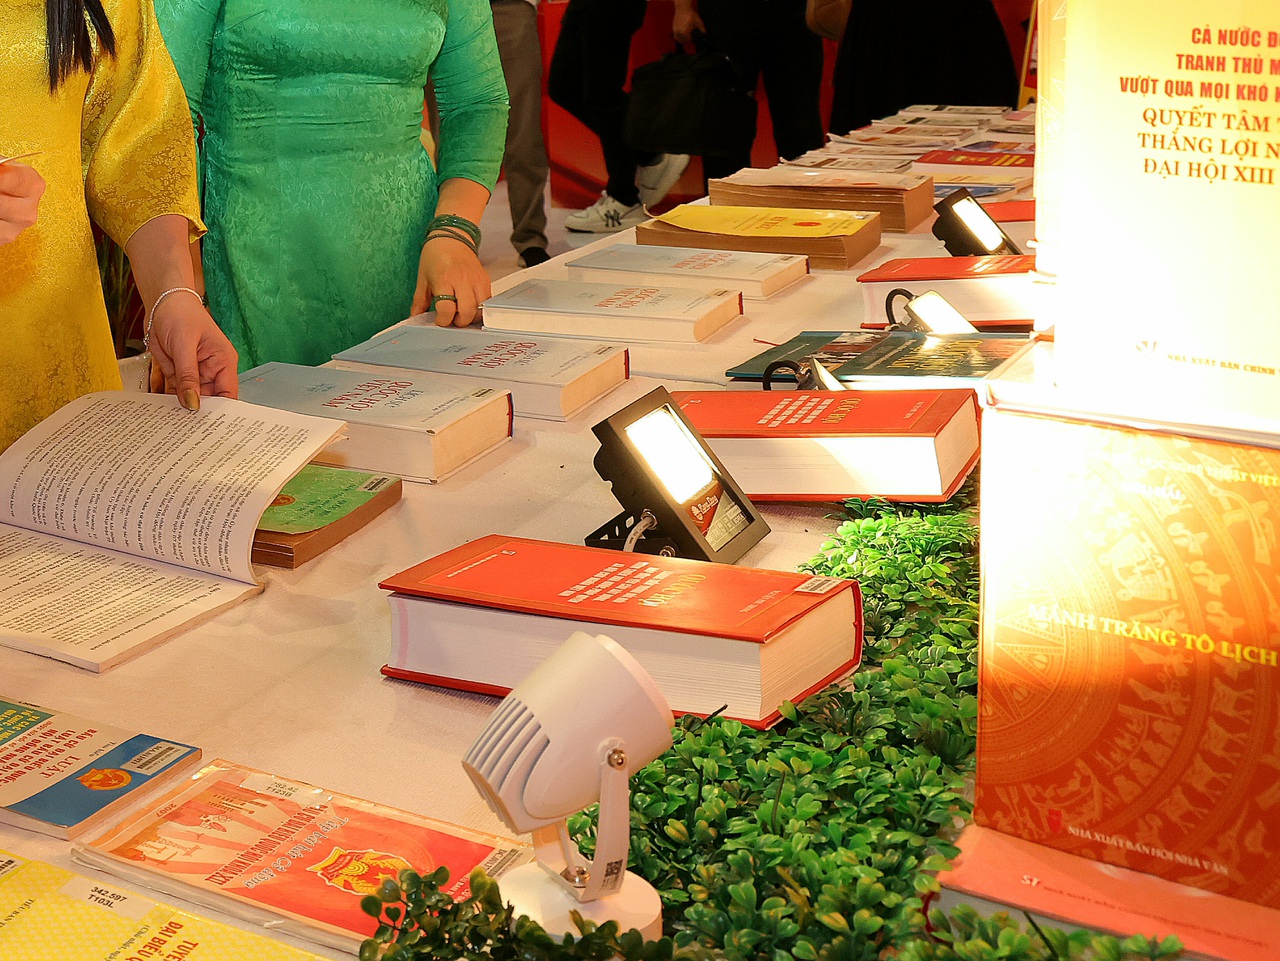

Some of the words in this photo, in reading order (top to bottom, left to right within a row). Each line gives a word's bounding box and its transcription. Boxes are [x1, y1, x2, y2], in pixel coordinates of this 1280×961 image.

[1192, 24, 1212, 45] CẢ
[1218, 24, 1261, 48] NƯỚC
[1176, 53, 1227, 73] TRANH
[1233, 53, 1264, 75] THỦ
[1119, 75, 1159, 98] VƯỢT
[1164, 80, 1194, 99] QUA
[1200, 82, 1230, 103] MỌI
[1236, 81, 1269, 103] KHÓ
[1142, 104, 1217, 129] QUYẾT
[1222, 109, 1270, 133] TÂM
[1137, 127, 1213, 155] THẮNG
[1220, 137, 1258, 161] LỢI
[1143, 157, 1180, 180] ĐẠI
[1187, 159, 1227, 184] HỘI
[1233, 165, 1276, 186] XIII
[346, 378, 397, 392] VIỆT
[361, 380, 424, 399] QUỐC
[314, 391, 370, 408] NAM
[337, 397, 390, 412] HỘI
[1099, 616, 1178, 647] TRĂNG
[1181, 633, 1216, 654] TÔ
[1221, 642, 1279, 667] LỊCH
[33, 754, 85, 779] LUẬT
[155, 803, 178, 818] 2007
[87, 893, 115, 909] T103L
[89, 885, 128, 903] 342.597
[158, 921, 184, 938] ĐẠI
[137, 936, 168, 958] BIỂU
